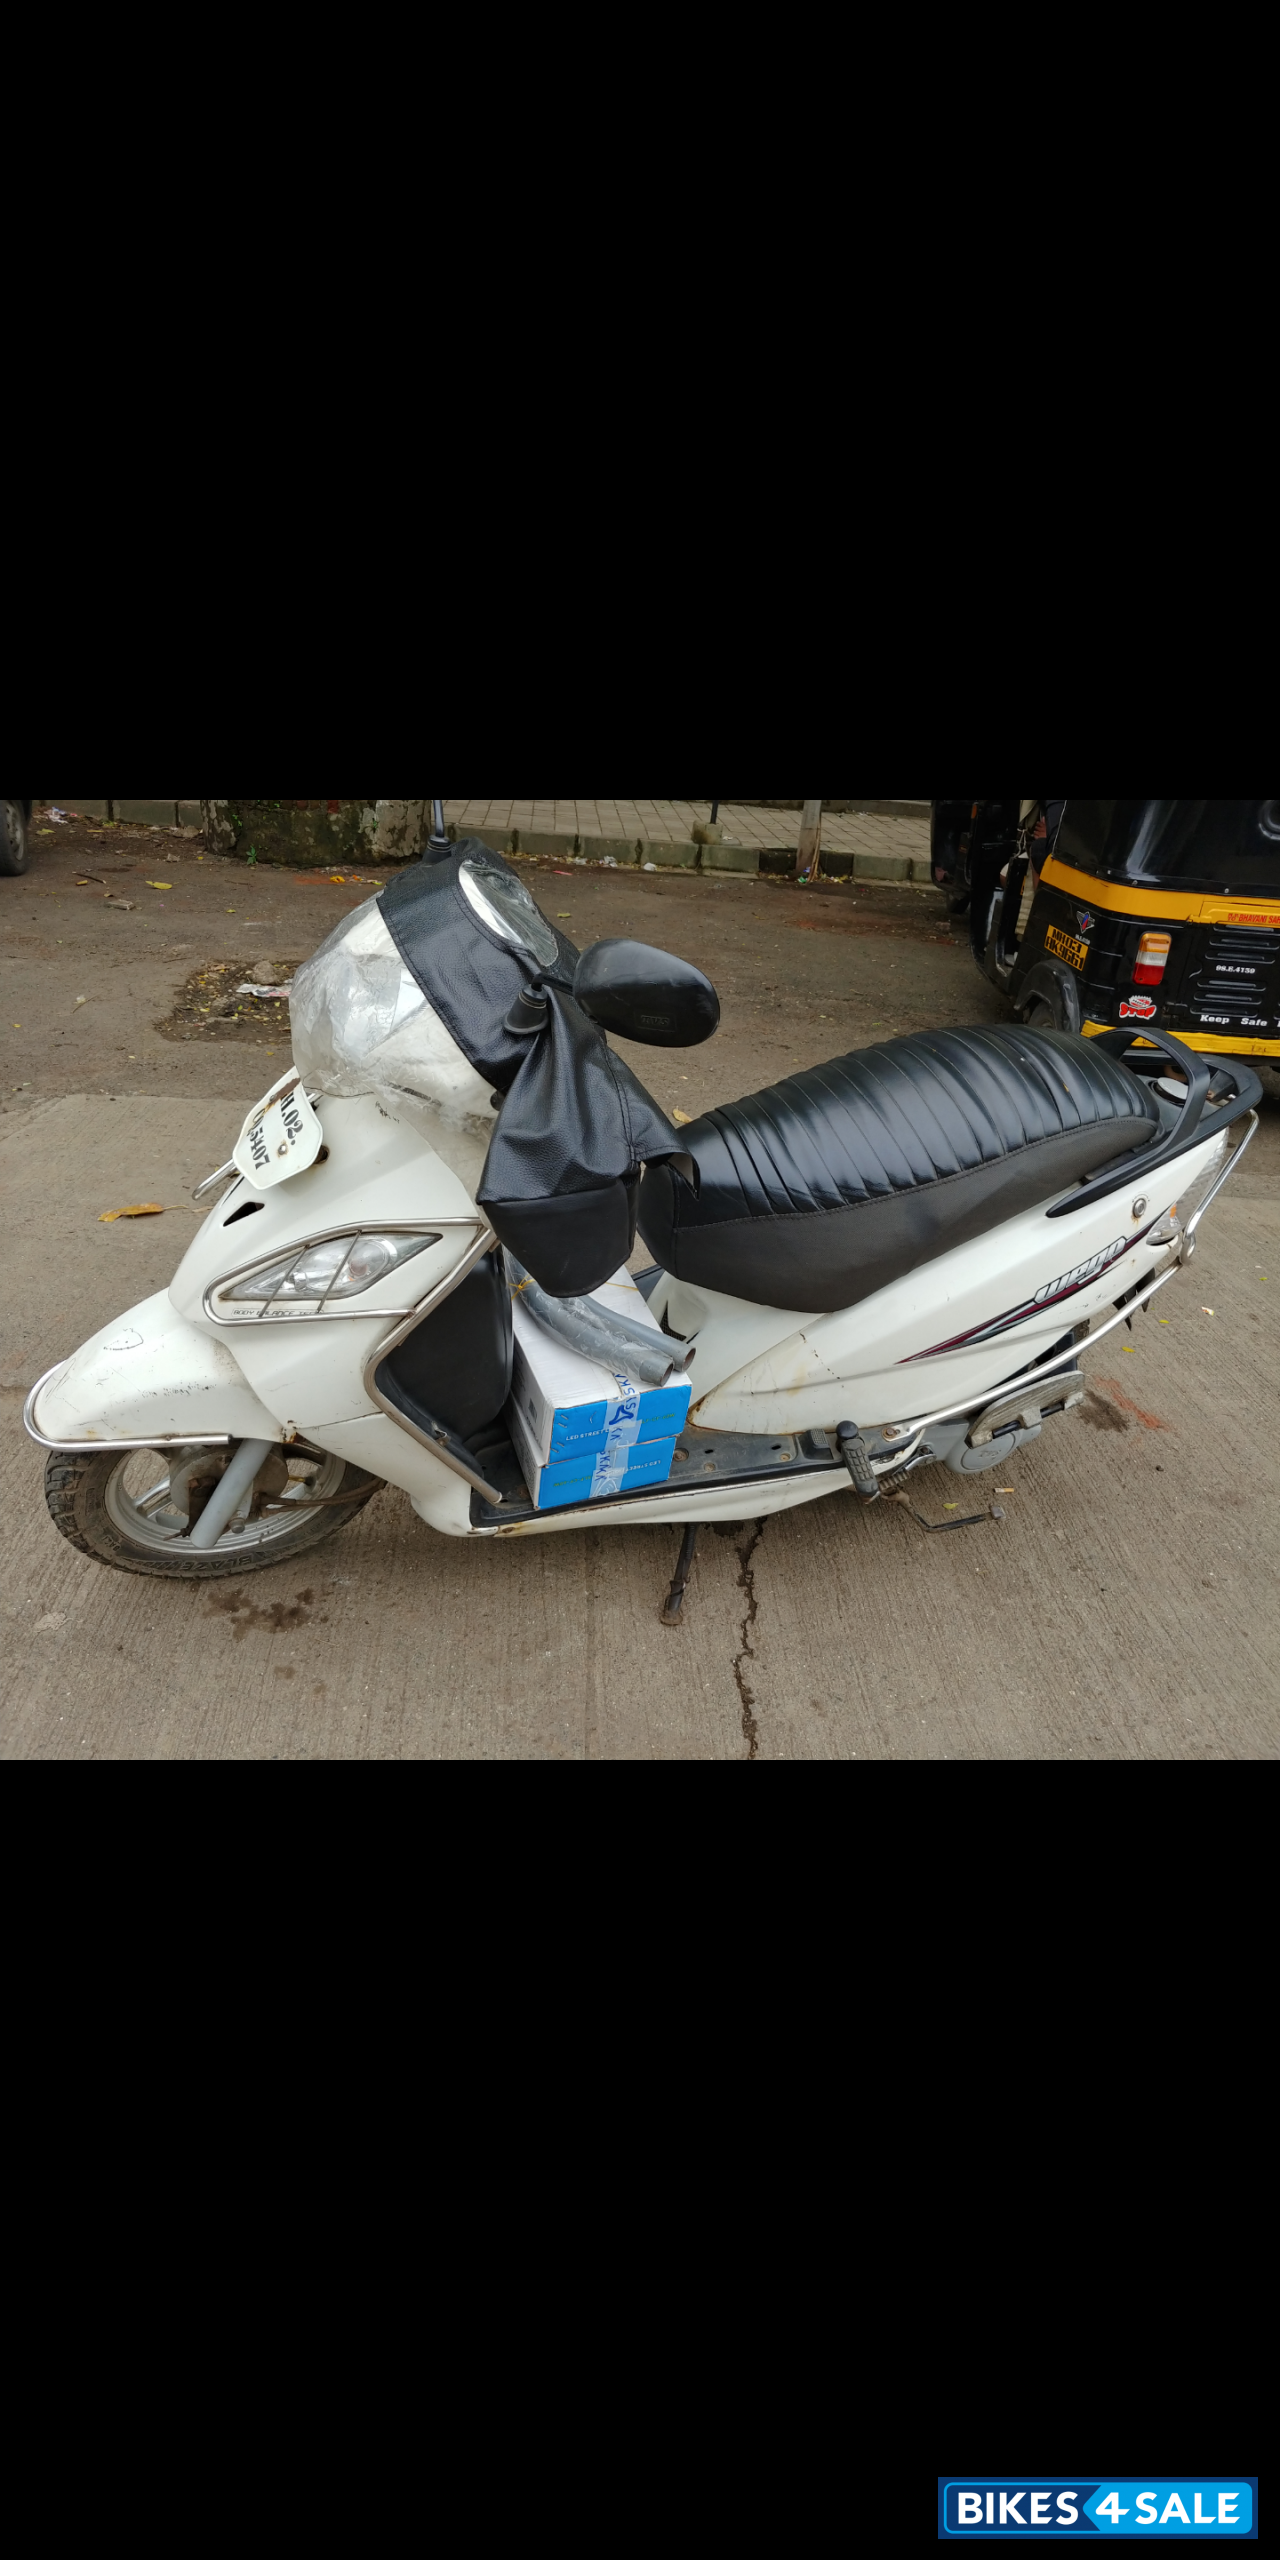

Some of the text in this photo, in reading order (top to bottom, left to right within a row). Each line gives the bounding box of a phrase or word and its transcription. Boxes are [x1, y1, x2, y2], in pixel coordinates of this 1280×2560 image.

[1052, 928, 1082, 954] MH03
[1045, 936, 1084, 970] AK9661
[1200, 1014, 1230, 1025] Keep
[1240, 1017, 1268, 1027] Safe
[566, 1433, 579, 1441] LED
[580, 1428, 606, 1439] STREET
